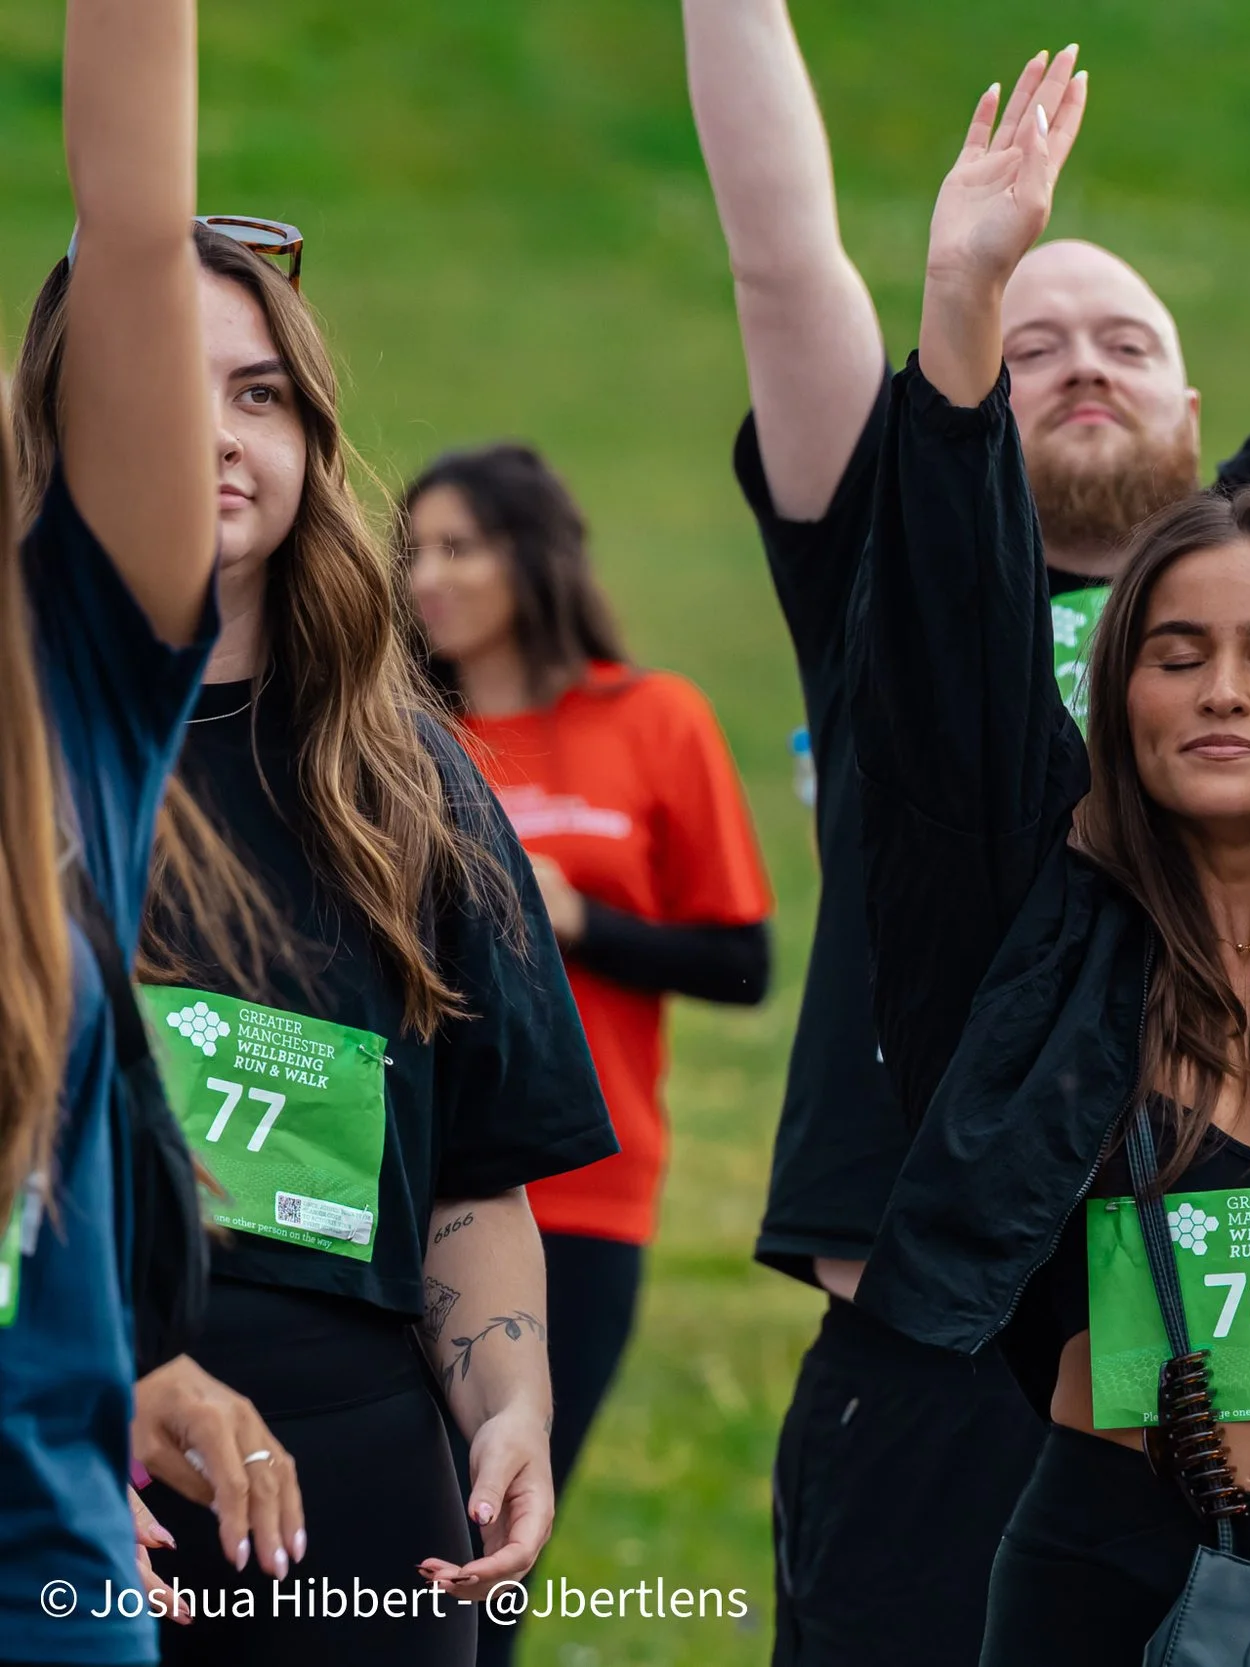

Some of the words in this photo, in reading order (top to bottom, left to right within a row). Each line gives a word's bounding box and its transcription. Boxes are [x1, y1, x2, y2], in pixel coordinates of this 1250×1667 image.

[239, 1008, 303, 1035] GREATER
[237, 1023, 336, 1060] MANCHESTER
[237, 1039, 324, 1071] WELLBEING
[233, 1055, 267, 1074] RUN
[269, 1064, 280, 1078] &
[284, 1067, 329, 1089] WALK
[205, 1076, 287, 1153] 77
[213, 1214, 231, 1225] one
[232, 1215, 257, 1229] other
[257, 1222, 288, 1238] person
[289, 1230, 301, 1240] on
[302, 1231, 317, 1243] the
[316, 1236, 333, 1249] way
[433, 1211, 474, 1244] 6866
